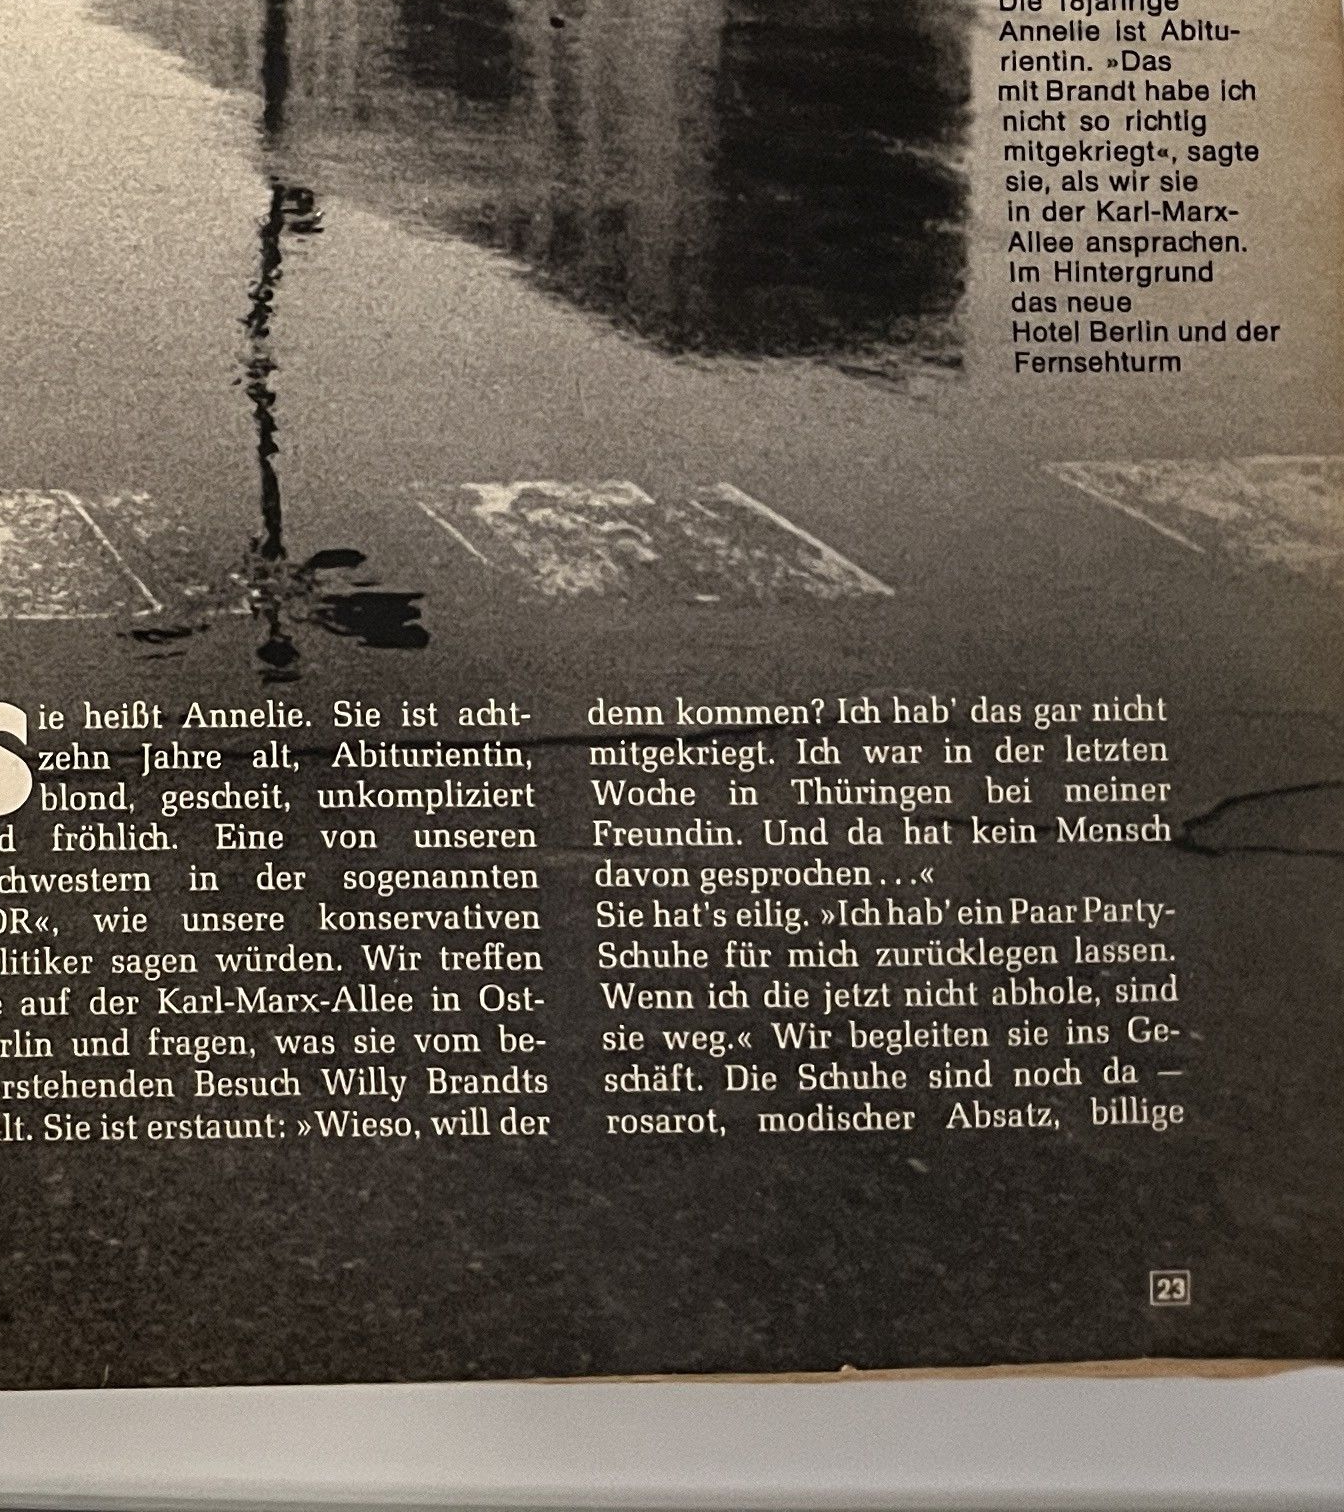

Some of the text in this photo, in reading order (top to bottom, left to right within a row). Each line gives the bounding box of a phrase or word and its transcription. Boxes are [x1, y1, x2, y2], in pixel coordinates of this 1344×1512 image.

[998, 18, 1241, 42] Annelie ist Abitu-
[1000, 49, 1172, 72] rientin. »Das
[998, 78, 1256, 102] mit Brandt habe ich
[1002, 108, 1207, 138] nicht so richtig
[1004, 139, 1259, 168] mitgekriegt«, sagte
[1005, 169, 1199, 196] sie, als wir sie
[1007, 199, 1239, 223] in der Karl-Marx-
[1007, 230, 1248, 258] Allee ansprachen.
[1009, 259, 1214, 289] Im Hintergrund
[1010, 291, 1132, 314] das neue
[1011, 319, 1281, 344] Hotel Berlin und der
[1014, 350, 1182, 374] Fernsehturm
[82, 700, 163, 730] heißt
[181, 699, 312, 729] Annelie.
[333, 700, 381, 728] Sie
[401, 700, 439, 727] ist
[458, 697, 531, 727] acht-
[587, 693, 1167, 731] denn kommen? Ich hab' das gar nicht
[38, 739, 532, 777] zehn Jahre alt, Abiturientin,
[589, 734, 1169, 774] mitgekriegt. Ich war in der letzten
[39, 779, 536, 818] blond, gescheit, unkompliziert
[592, 775, 1172, 812] Woche in Thüringen bei meiner
[51, 821, 178, 852] fröhlich.
[214, 823, 284, 850] Eine
[319, 829, 378, 849] von
[413, 828, 538, 849] unseren
[592, 813, 1172, 847] Freundin. Und da hat kein Mensch
[189, 864, 219, 892] in
[256, 861, 307, 891] der
[343, 864, 539, 897] sogenannten
[595, 858, 690, 888] davon
[92, 905, 148, 933] wie
[180, 912, 285, 932] unsere
[318, 902, 541, 931] konservativen
[111, 953, 198, 982] sagen
[214, 943, 343, 973] würden.
[361, 944, 422, 972] Wir
[439, 941, 544, 971] treffen
[20, 986, 71, 1017] auf
[89, 986, 140, 1016] der
[157, 983, 413, 1015] Karl-Marx-Allee
[431, 985, 461, 1012] in
[479, 984, 545, 1012] Ost-
[70, 1027, 130, 1057] und
[148, 1026, 256, 1064] fragen,
[273, 1035, 336, 1055] was
[353, 1026, 396, 1054] sie
[413, 1033, 481, 1053] vom
[497, 1023, 547, 1053] be-
[194, 1067, 302, 1097] Besuch
[320, 1066, 407, 1103] Willy
[425, 1065, 548, 1095] Brandts
[43, 1113, 91, 1141] Sie
[99, 1113, 138, 1141] ist
[146, 1113, 286, 1141] erstaunt:
[297, 1110, 421, 1140] »Wieso,
[430, 1106, 492, 1136] will
[500, 1106, 551, 1136] der
[1157, 1277, 1185, 1300] 23
